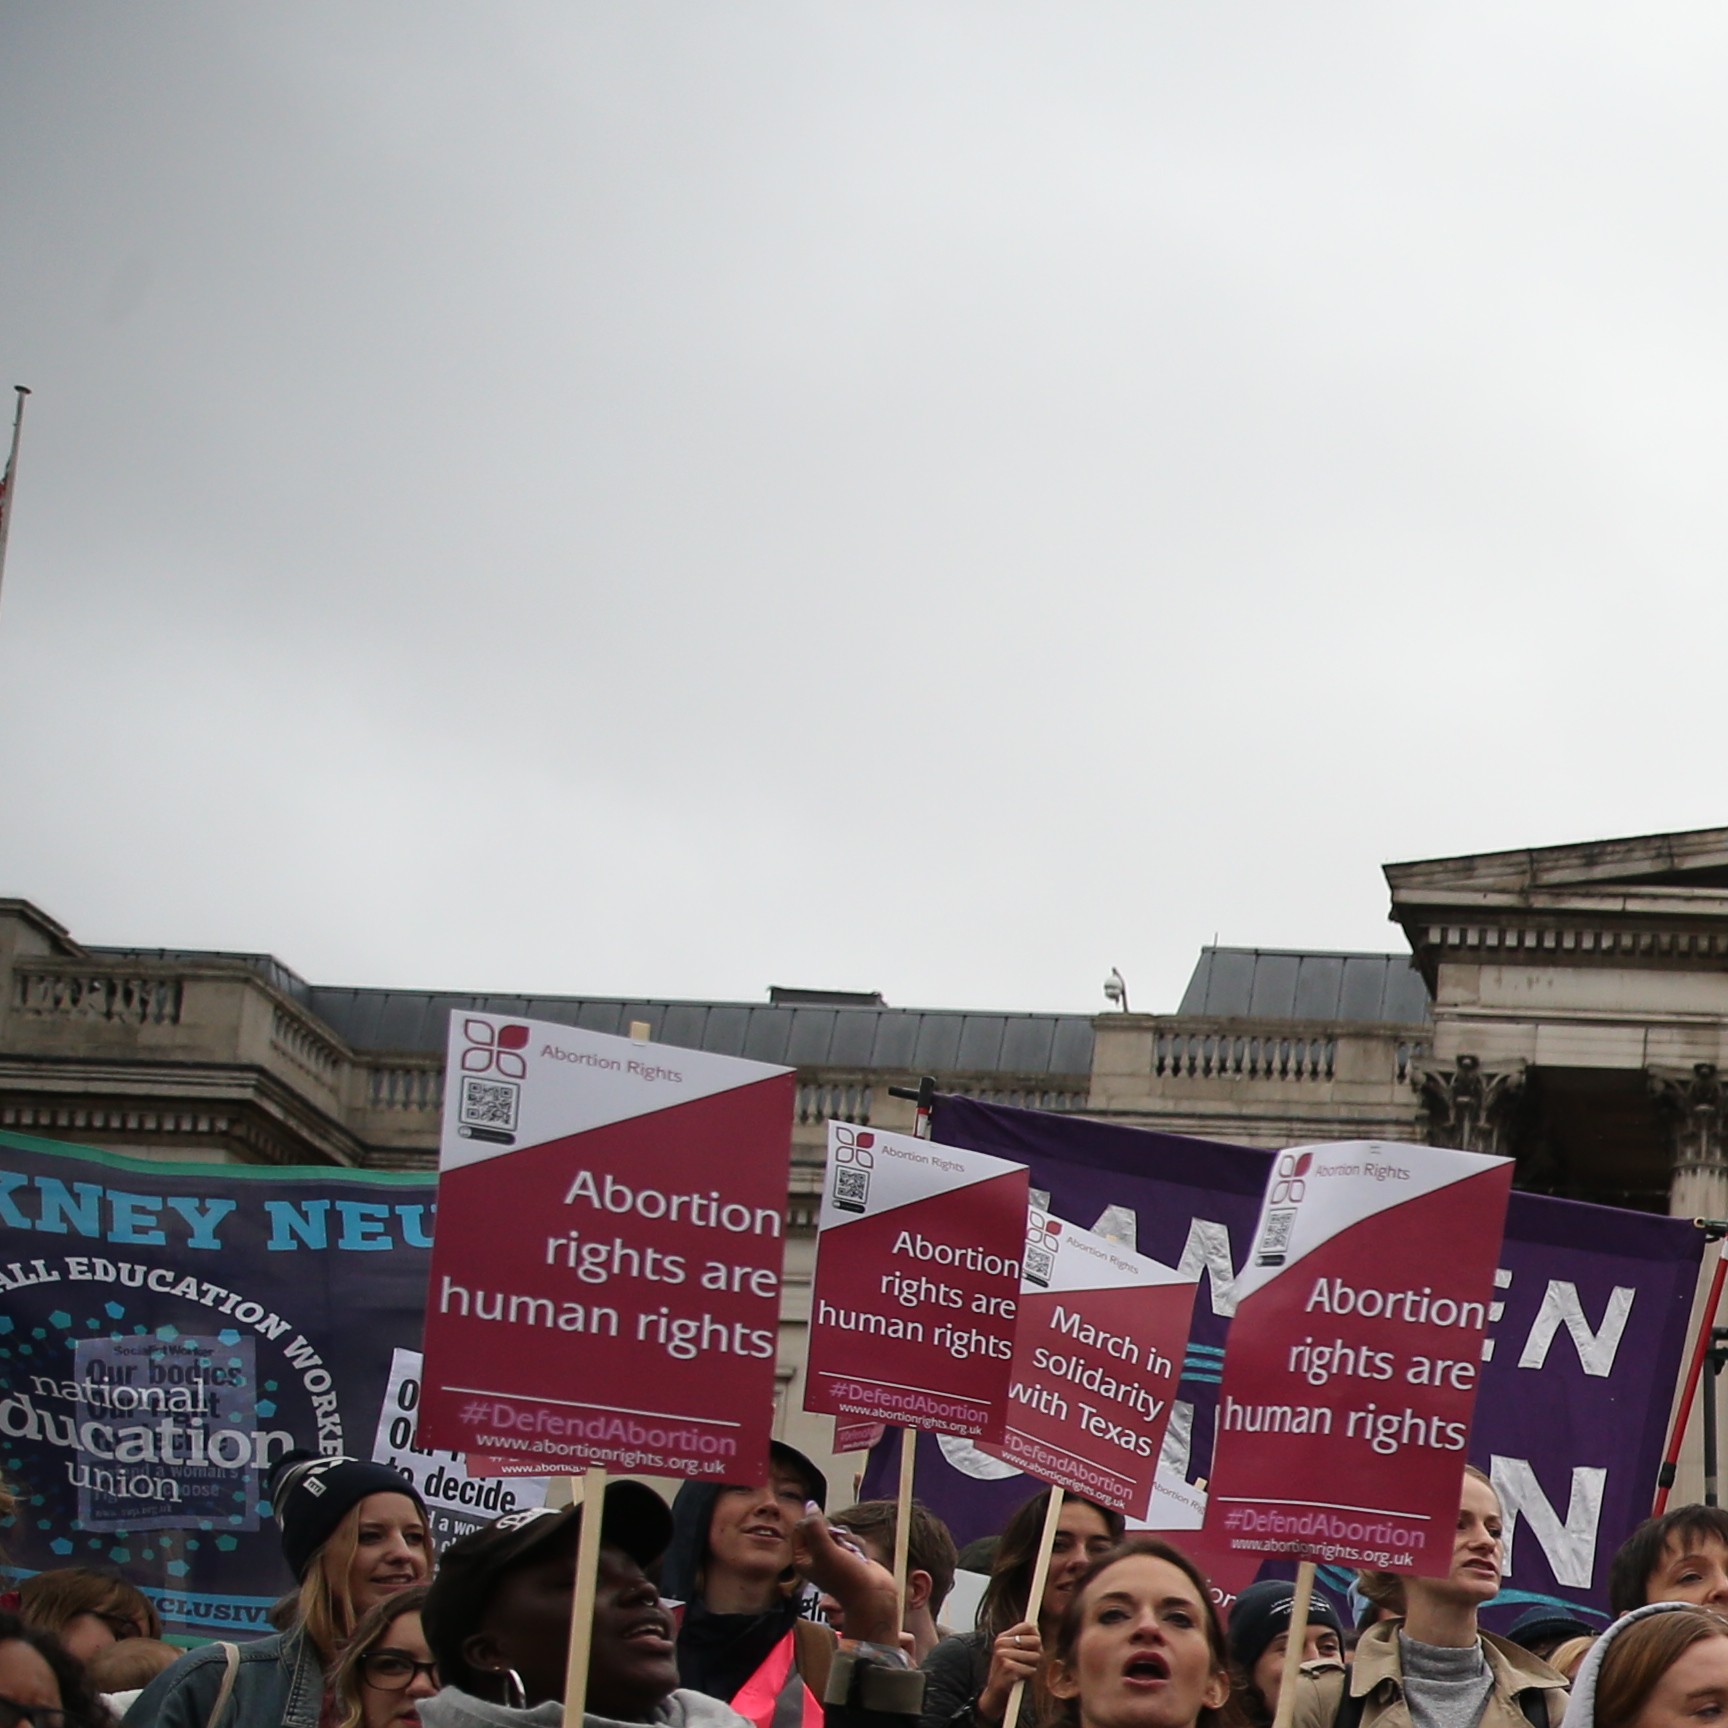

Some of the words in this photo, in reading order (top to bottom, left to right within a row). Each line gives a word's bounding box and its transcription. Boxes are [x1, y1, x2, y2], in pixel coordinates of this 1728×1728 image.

[540, 1044, 621, 1073] Abortion
[627, 1059, 683, 1084] Rights
[564, 1170, 781, 1237] Abortion
[545, 1231, 686, 1284] rights
[701, 1260, 778, 1299] are
[892, 1232, 1019, 1279] Abortion
[67, 1256, 292, 1340] EDUCATION
[440, 1277, 619, 1336] human
[637, 1306, 775, 1359] rights
[881, 1271, 963, 1310] rights
[971, 1291, 1016, 1319] are
[1305, 1277, 1486, 1330] Abortion
[818, 1300, 923, 1342] human
[933, 1322, 1012, 1360] rights
[1050, 1306, 1137, 1364] March
[1149, 1347, 1172, 1379] in
[1032, 1347, 1165, 1423] solidarity
[1288, 1338, 1394, 1386] rights
[1406, 1356, 1475, 1390] are
[30, 1374, 208, 1414] national
[831, 1382, 988, 1424] #DefendAbortion
[1008, 1380, 1071, 1423] with
[1080, 1402, 1152, 1457] Texas
[460, 1400, 737, 1456] #DefendAbortion
[1223, 1397, 1331, 1436] human
[1347, 1404, 1467, 1454] rights
[476, 1432, 725, 1475] www.abortionrights.org.uk
[66, 1460, 183, 1502] union
[424, 1463, 517, 1514] decide
[1225, 1509, 1425, 1548] #DefendAbortion
